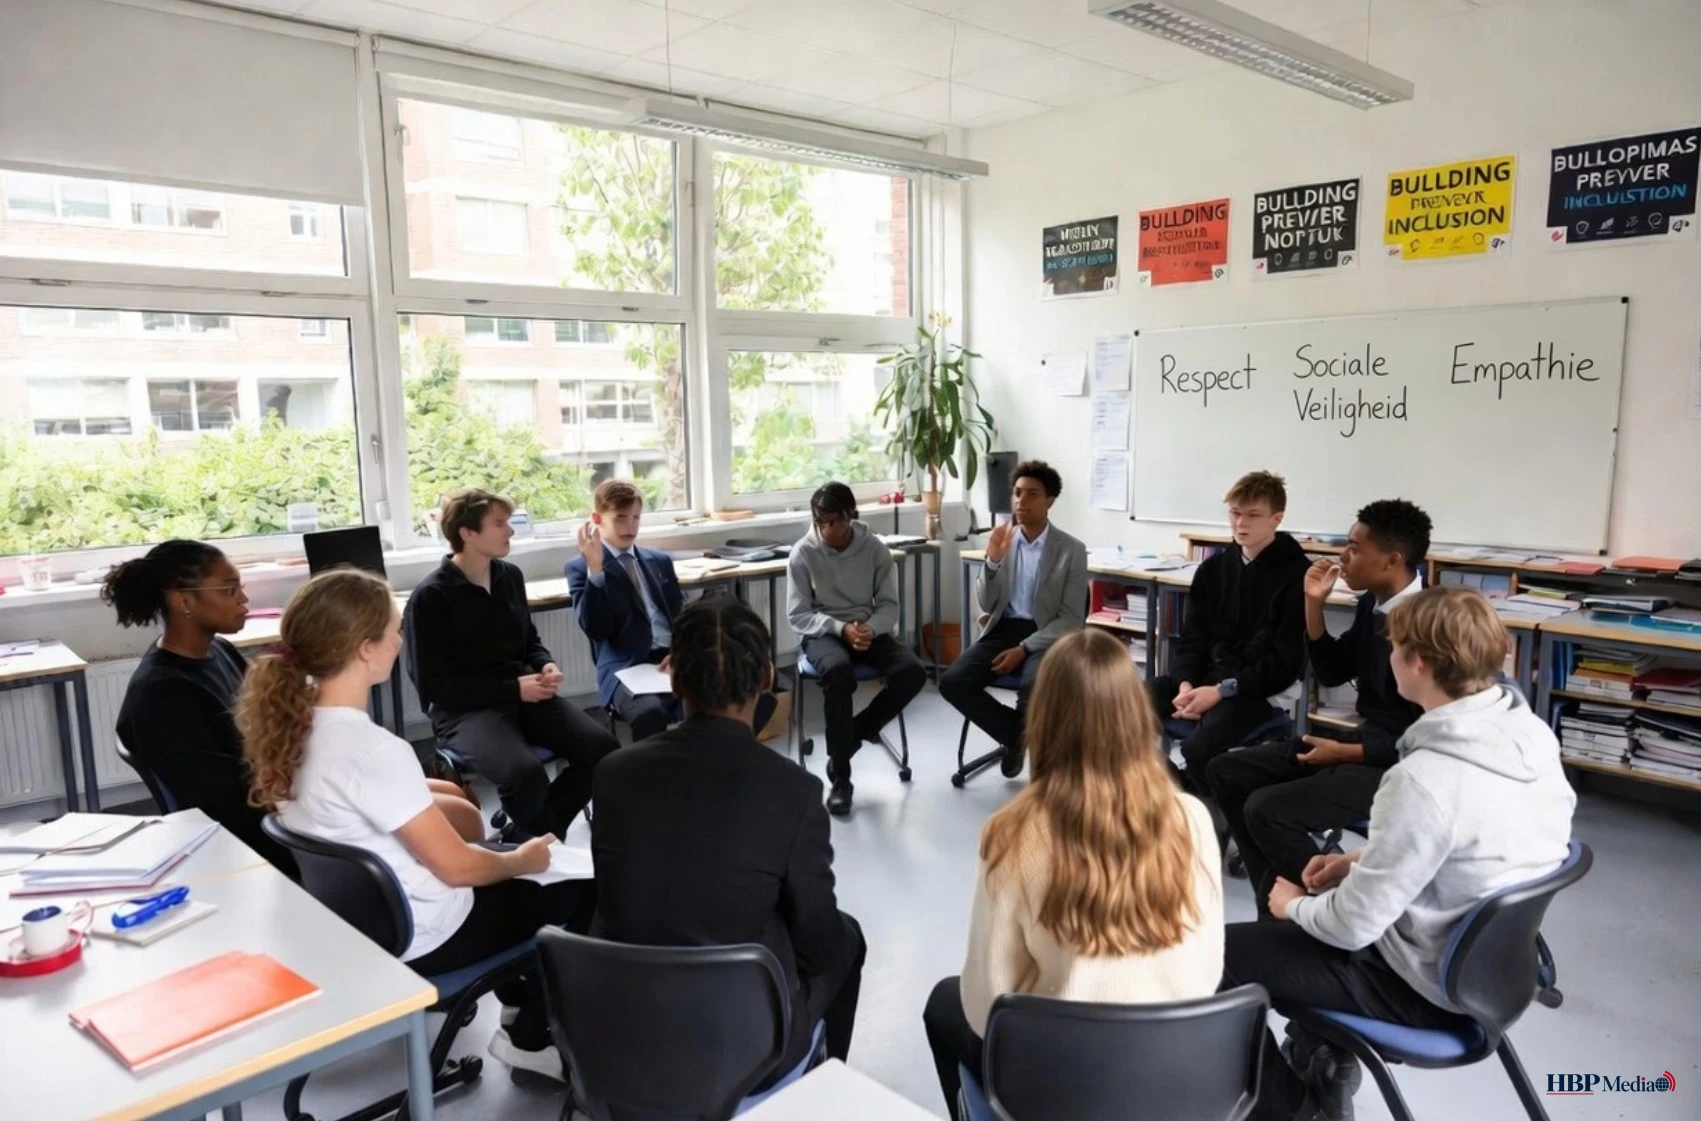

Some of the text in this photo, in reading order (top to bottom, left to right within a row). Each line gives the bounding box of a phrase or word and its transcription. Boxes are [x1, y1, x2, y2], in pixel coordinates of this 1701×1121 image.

[1388, 205, 1505, 235] INCLUSION
[1159, 352, 1258, 408] Respect
[1293, 343, 1390, 379] Sociale
[1450, 341, 1602, 399] Empathie
[1293, 386, 1409, 439] Veiligheid
